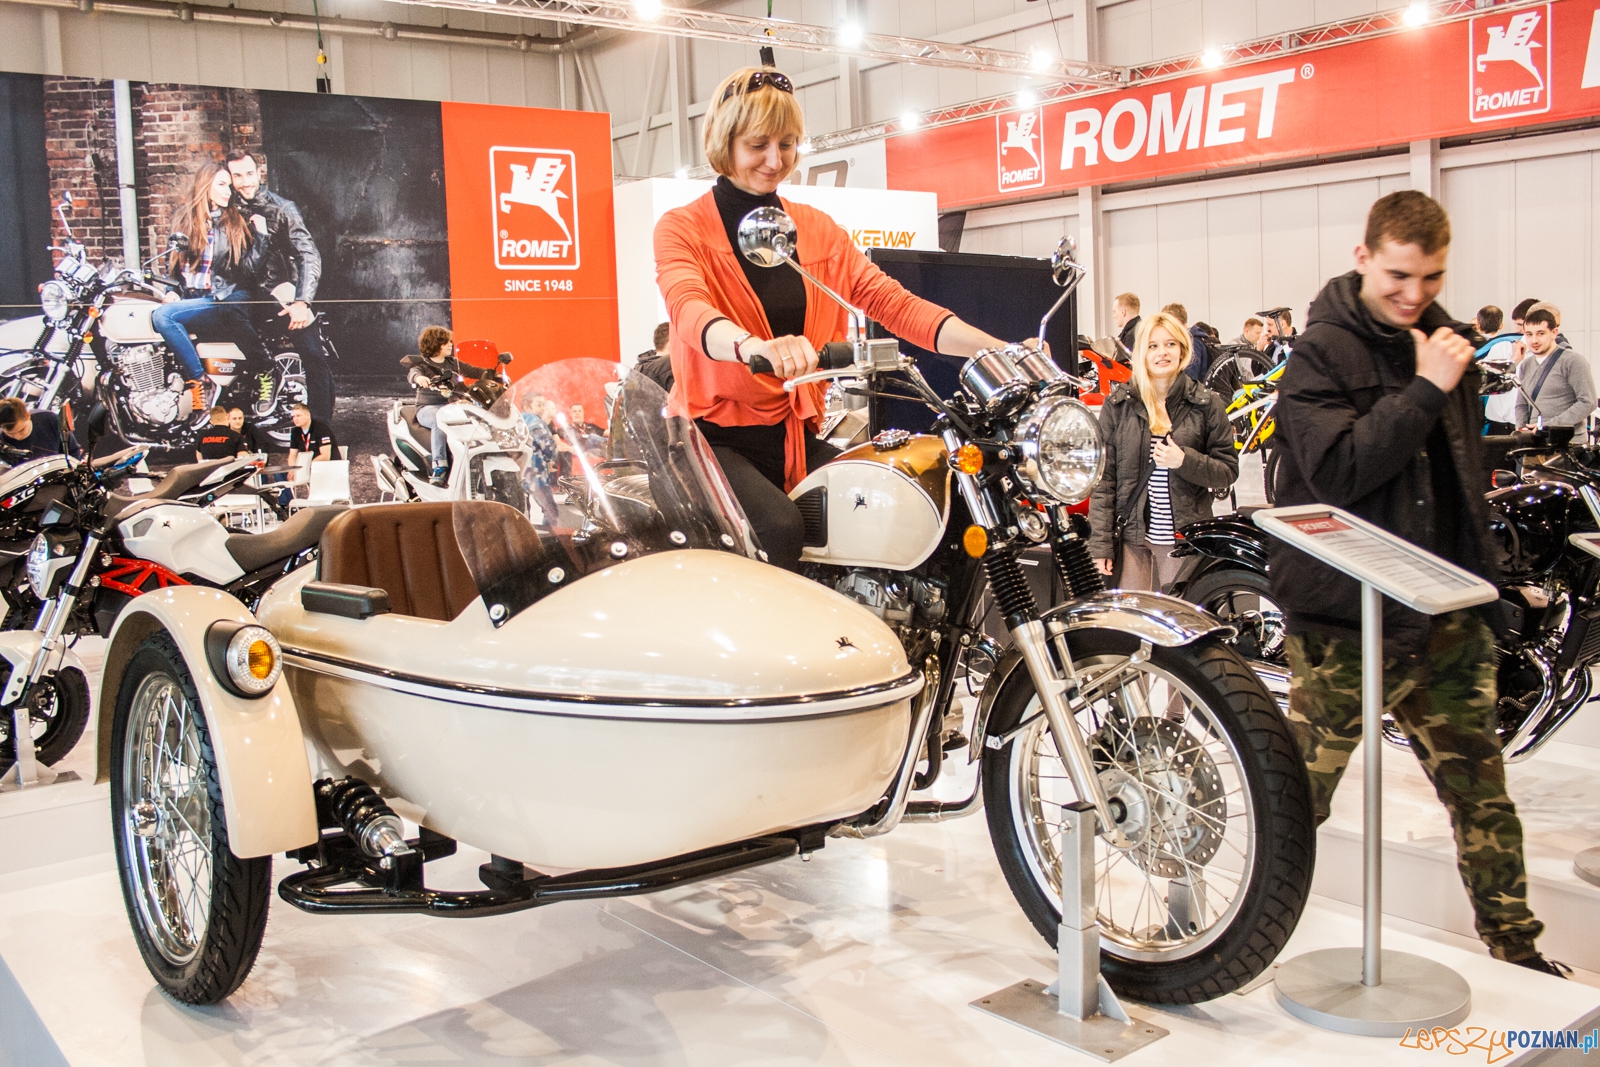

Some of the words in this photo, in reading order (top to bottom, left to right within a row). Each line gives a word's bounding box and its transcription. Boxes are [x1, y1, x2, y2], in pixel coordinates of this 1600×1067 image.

[1476, 87, 1544, 112] ROMET
[1060, 68, 1296, 170] ROMET
[1001, 167, 1040, 185] ROMET
[852, 229, 916, 248] KEEWAY
[501, 239, 572, 258] ROMET
[504, 279, 541, 292] SINCE
[544, 279, 573, 292] 1948
[202, 436, 230, 444] ROMET
[1298, 521, 1334, 532] ROMET
